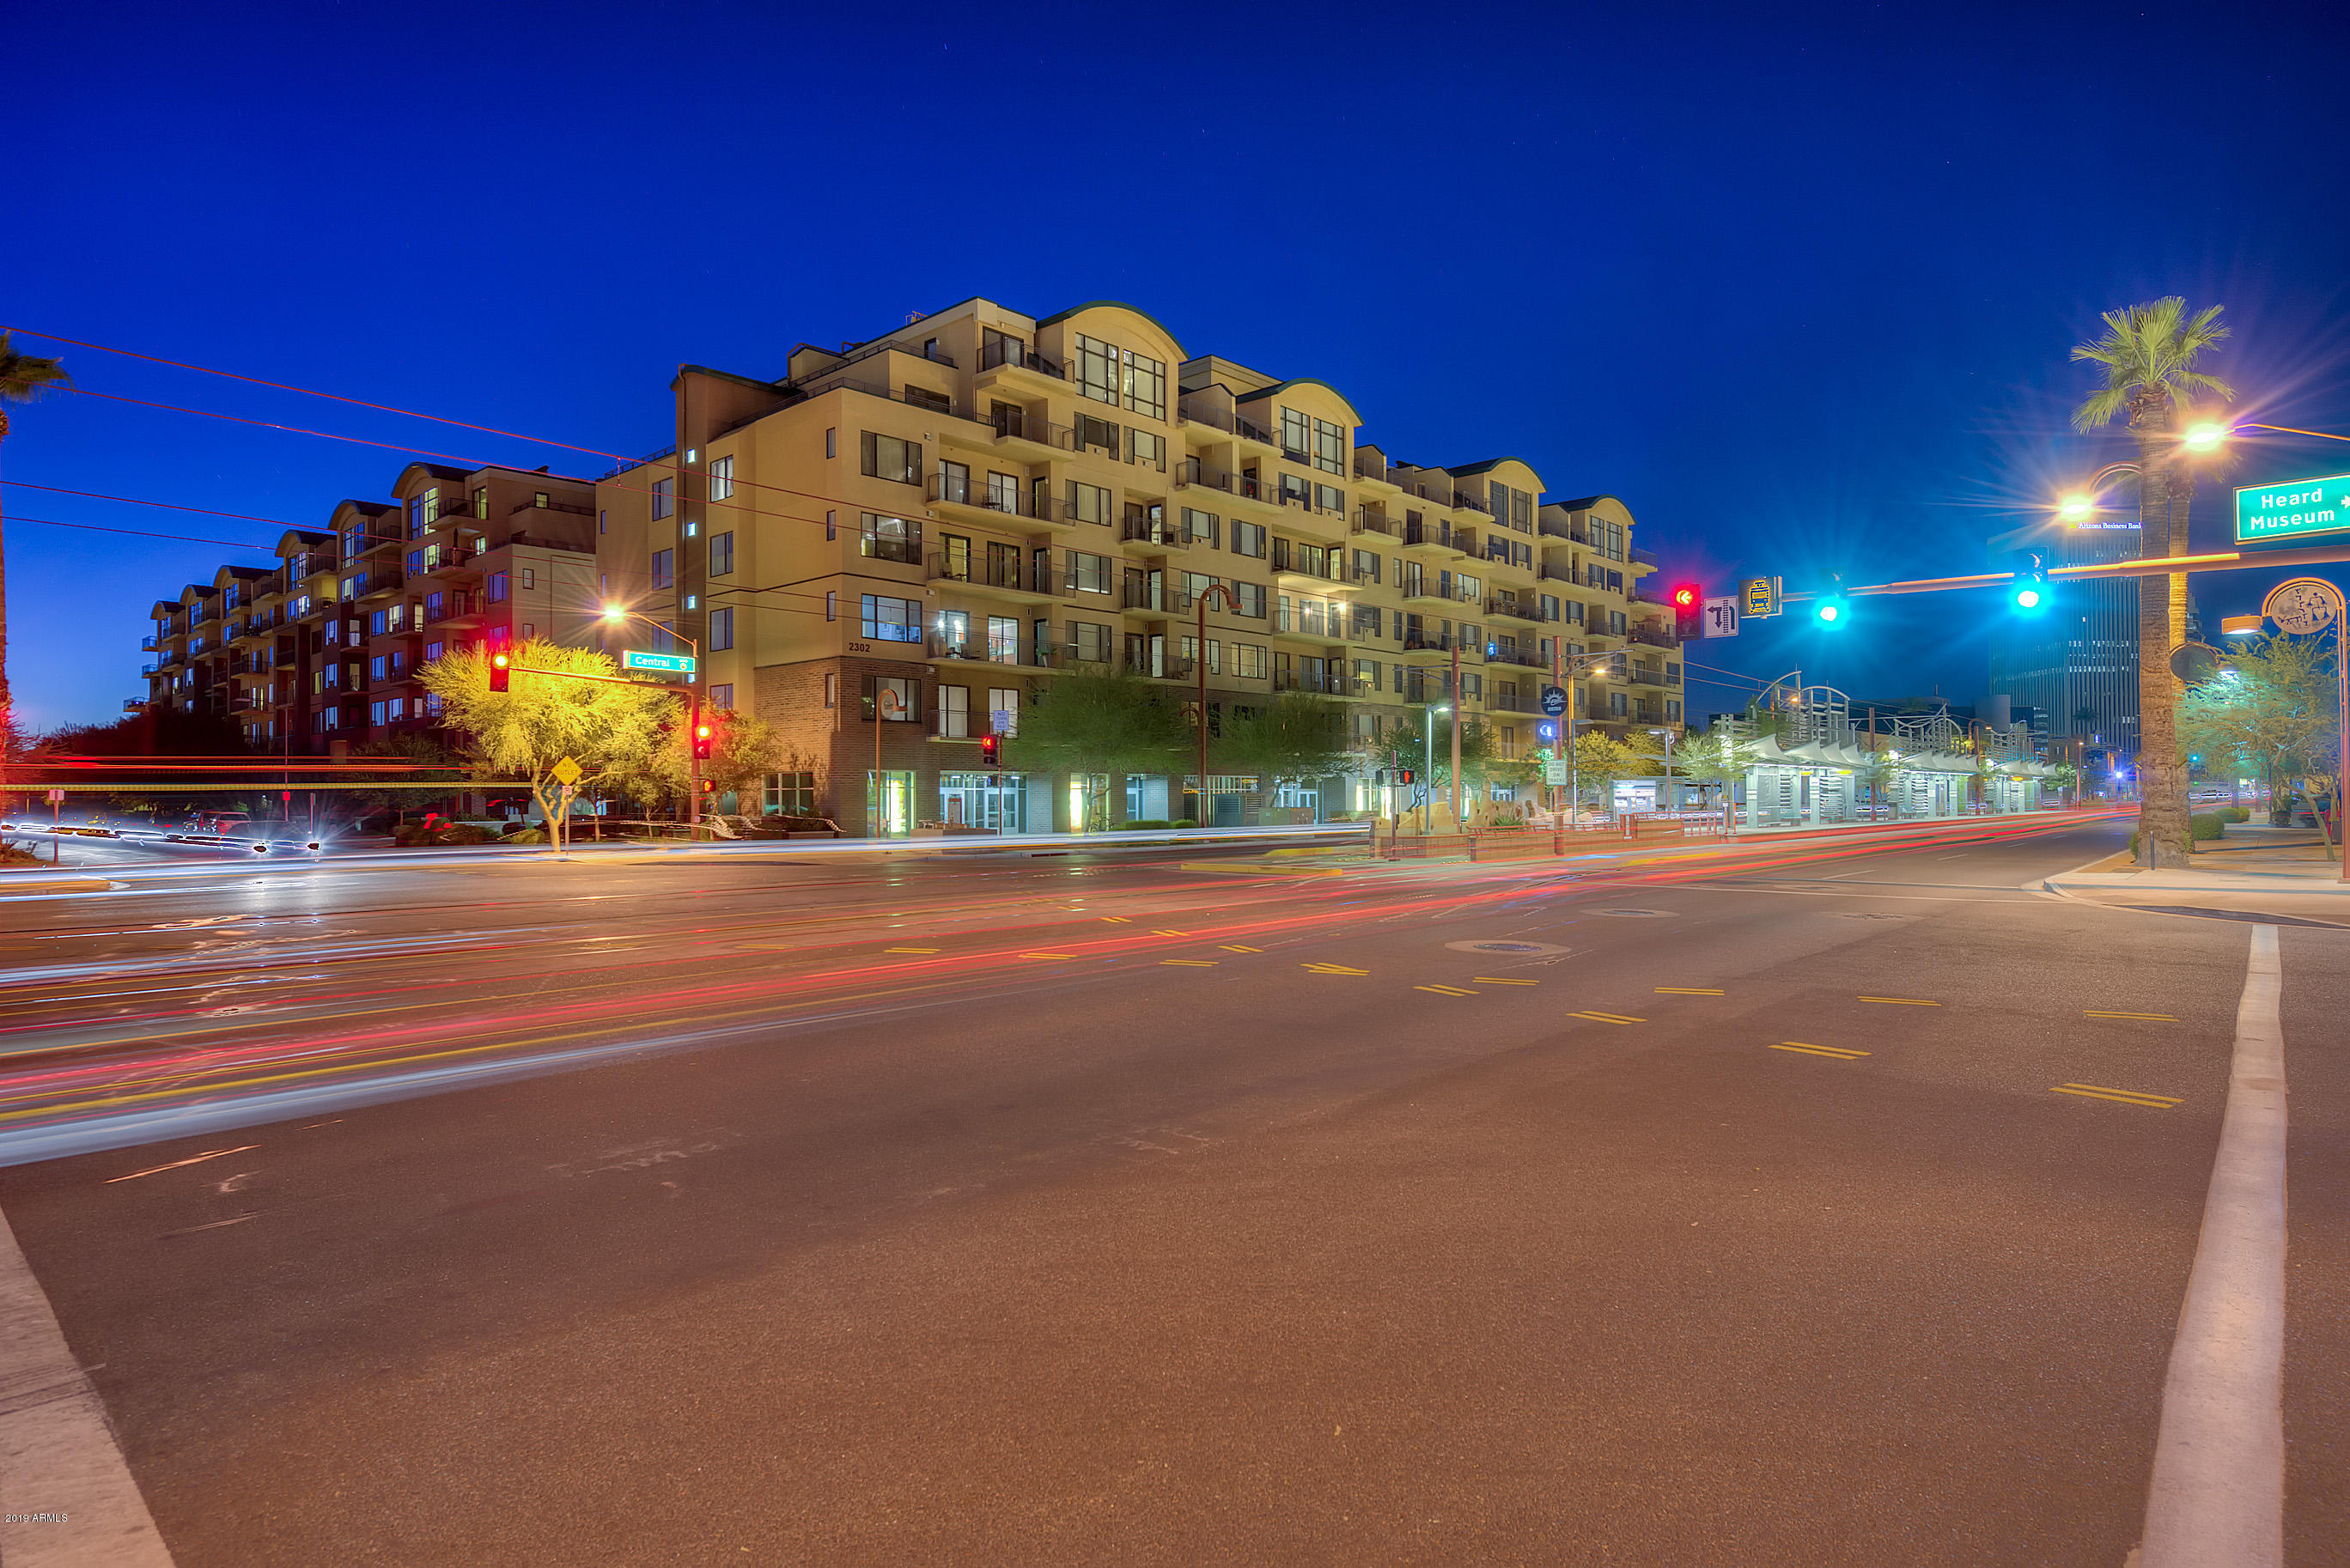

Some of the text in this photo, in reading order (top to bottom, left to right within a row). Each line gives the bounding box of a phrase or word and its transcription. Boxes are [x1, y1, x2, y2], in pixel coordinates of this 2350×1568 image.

[2261, 488, 2323, 508] Heard
[2250, 509, 2335, 530] Museum
[849, 642, 871, 653] 2302
[635, 656, 670, 667] Central
